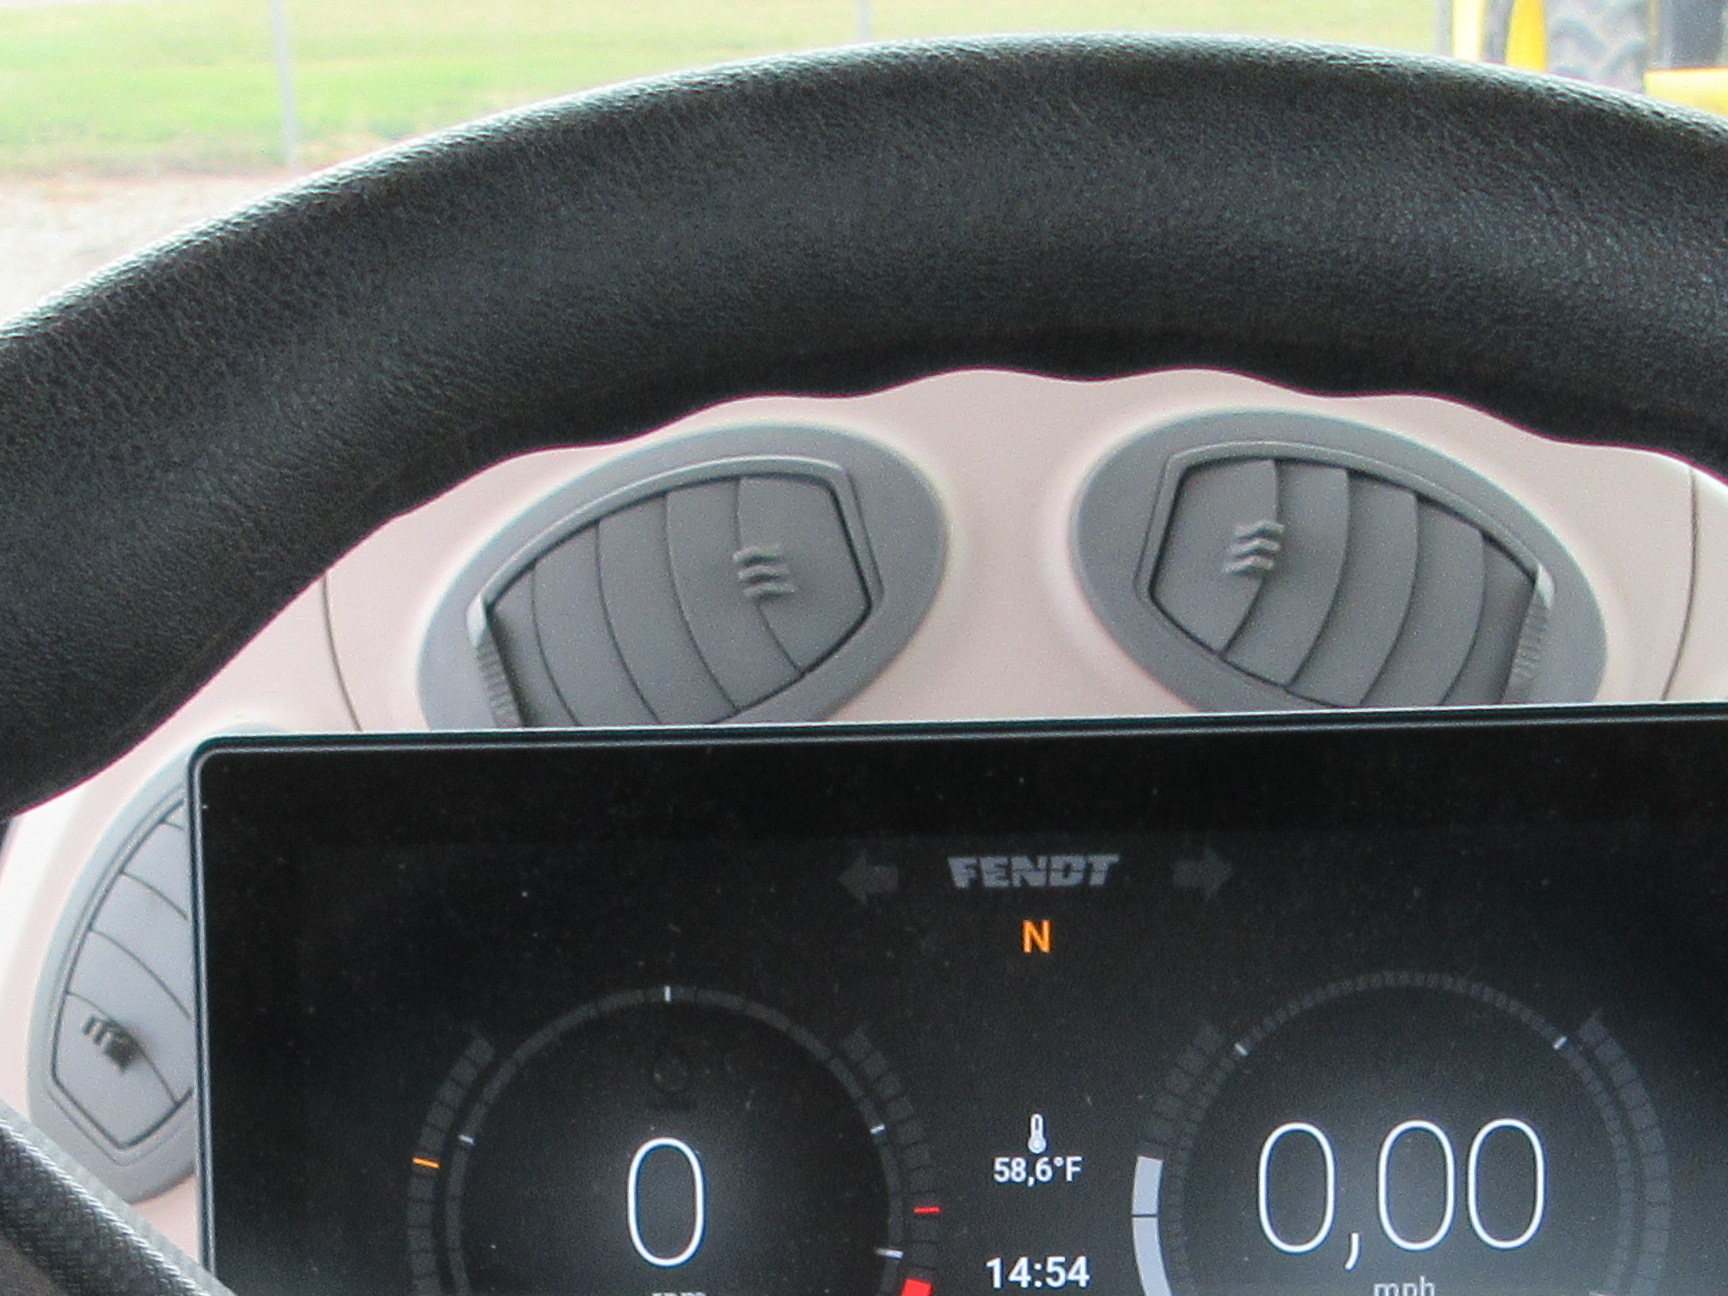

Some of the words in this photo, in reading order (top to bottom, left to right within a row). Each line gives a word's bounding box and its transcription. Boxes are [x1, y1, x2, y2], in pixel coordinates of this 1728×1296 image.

[947, 853, 1121, 889] FENDT
[1022, 918, 1053, 954] N
[993, 1155, 1084, 1188] 58,6°F
[627, 1136, 705, 1267] 0
[1258, 1118, 1545, 1271] 0,00
[985, 1255, 1091, 1289] 14:54
